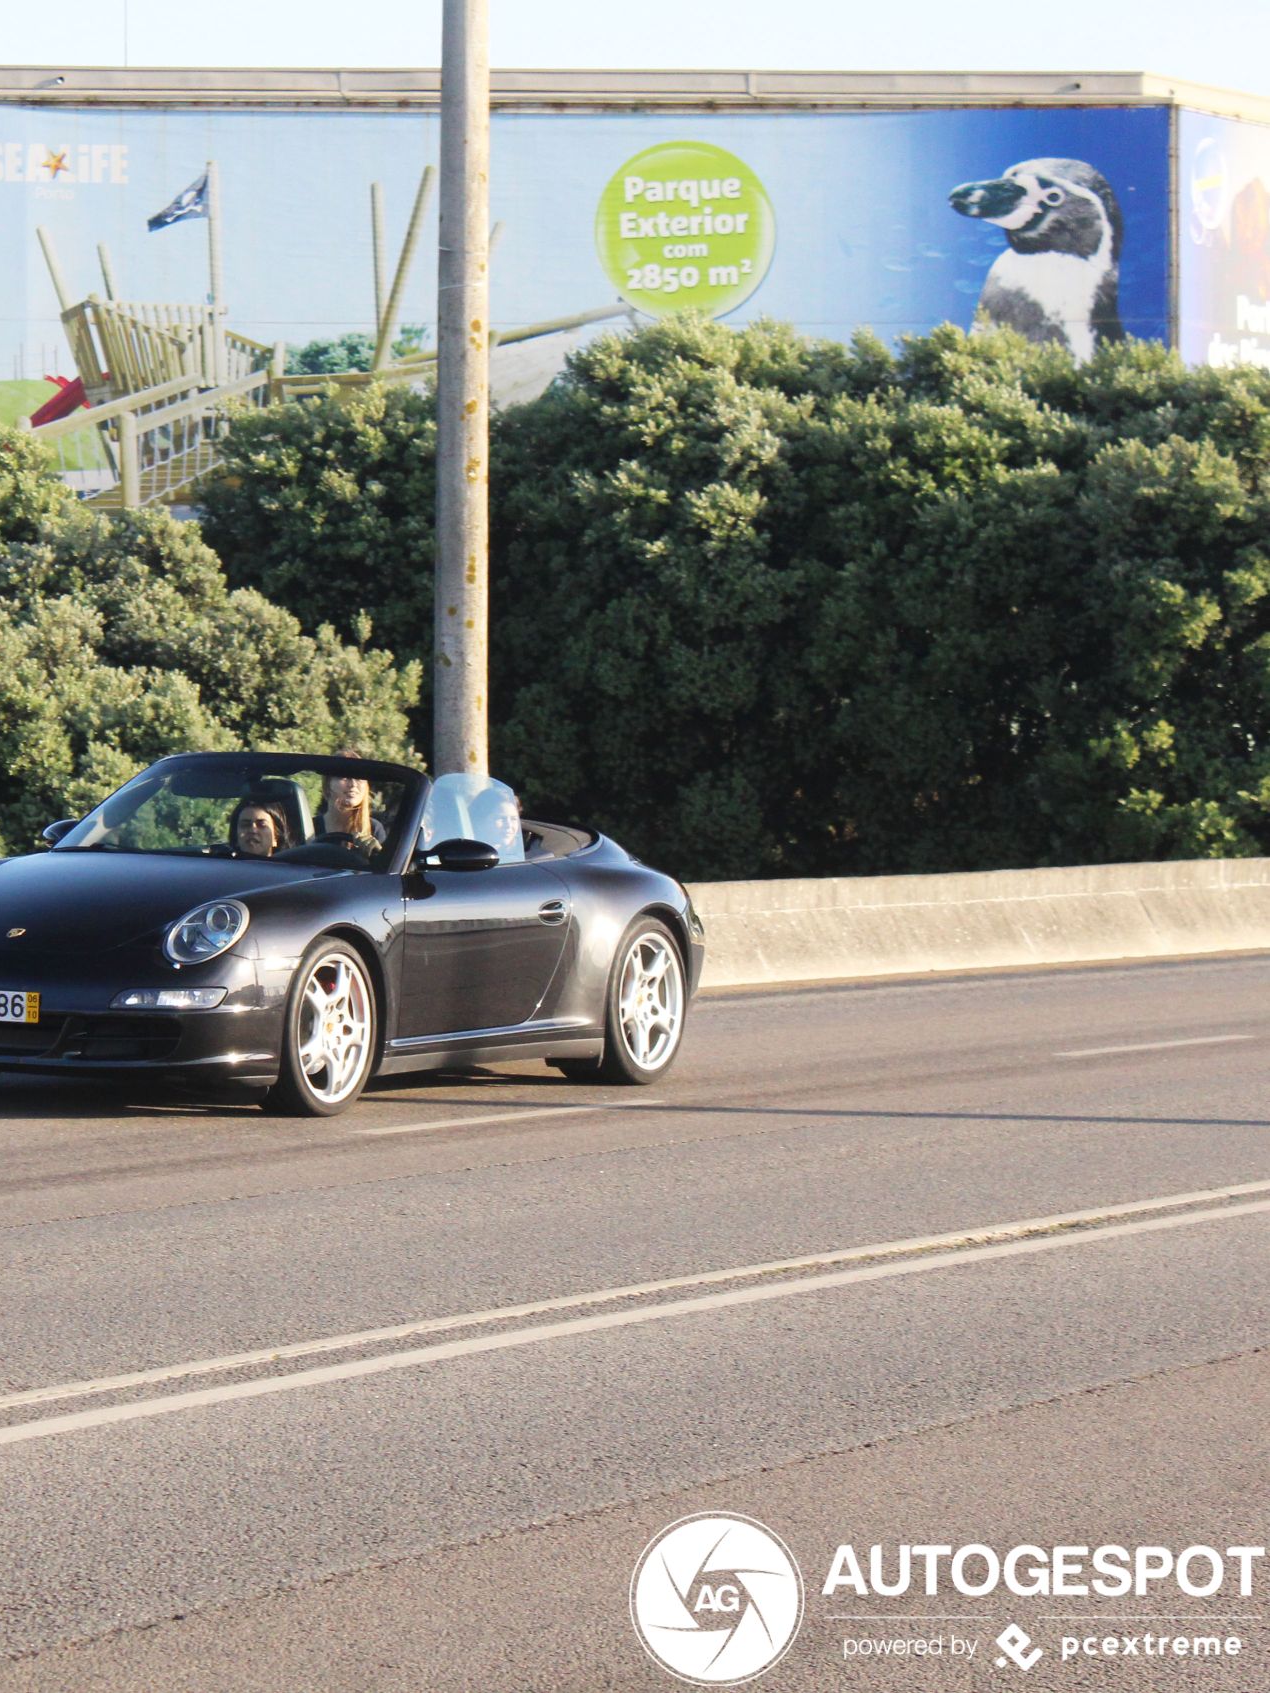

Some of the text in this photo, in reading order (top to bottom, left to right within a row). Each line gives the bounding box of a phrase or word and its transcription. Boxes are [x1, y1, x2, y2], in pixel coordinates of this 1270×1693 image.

[34, 187, 75, 200] Porto
[624, 176, 742, 208] Parque
[619, 206, 749, 239] Exterior
[662, 243, 709, 259] com
[626, 263, 701, 293] 2850
